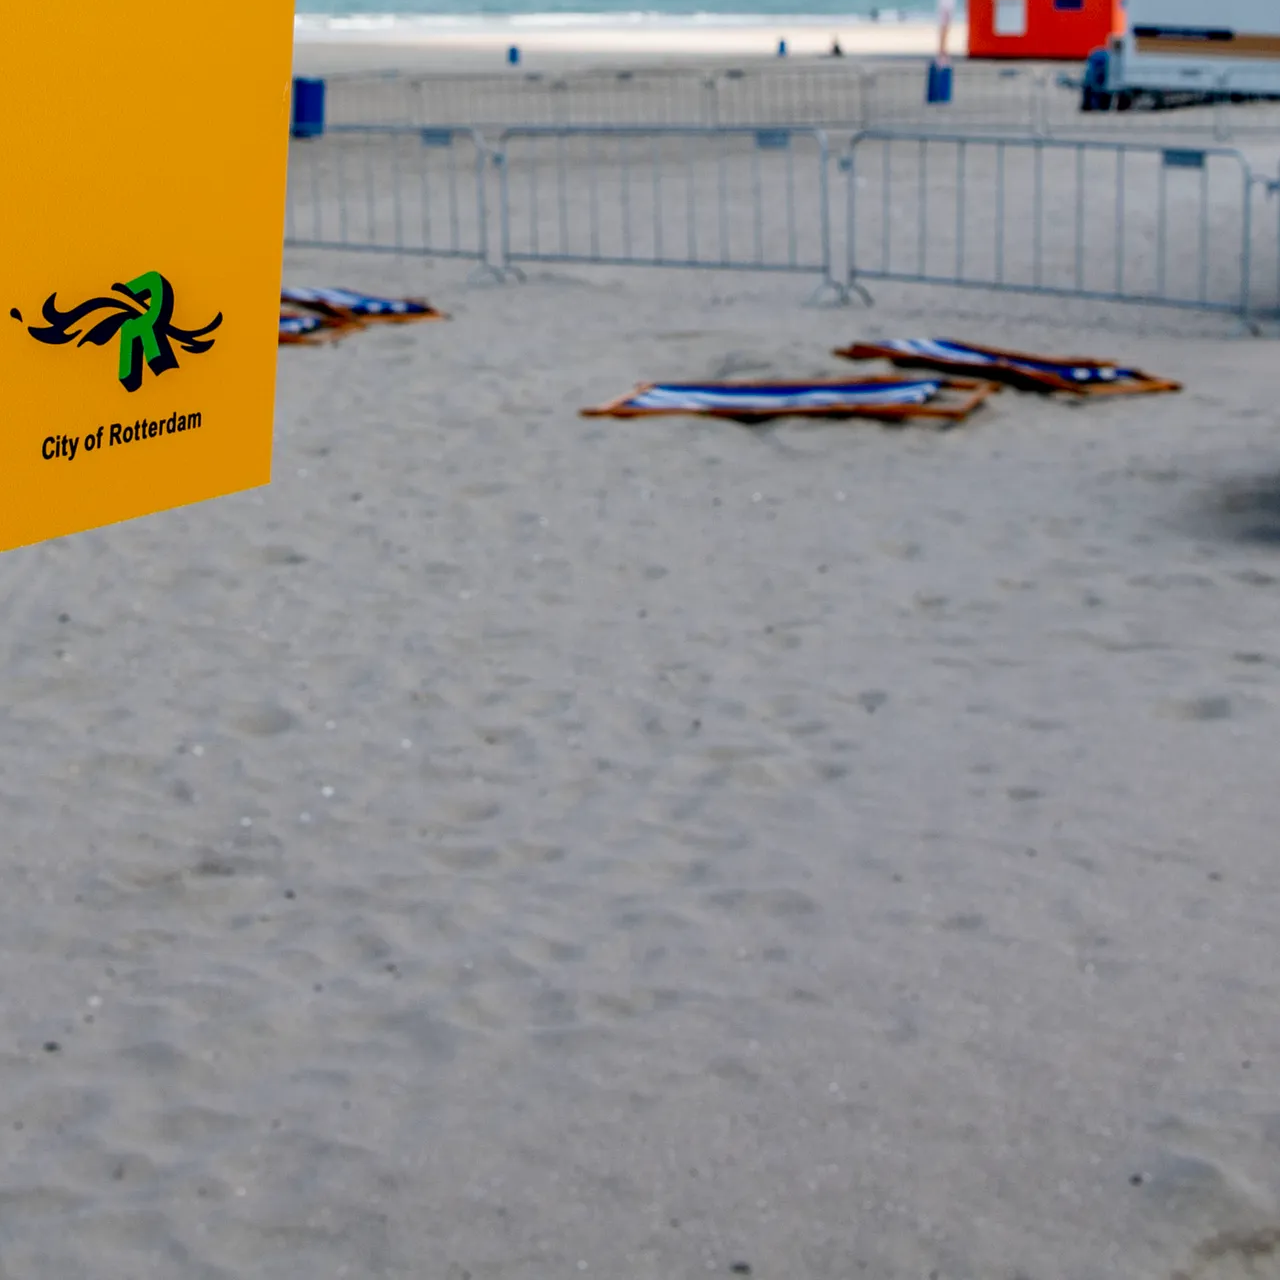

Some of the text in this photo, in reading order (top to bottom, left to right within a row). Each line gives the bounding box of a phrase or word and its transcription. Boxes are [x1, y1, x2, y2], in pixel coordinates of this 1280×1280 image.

[41, 411, 202, 461] City of Rotterdam
